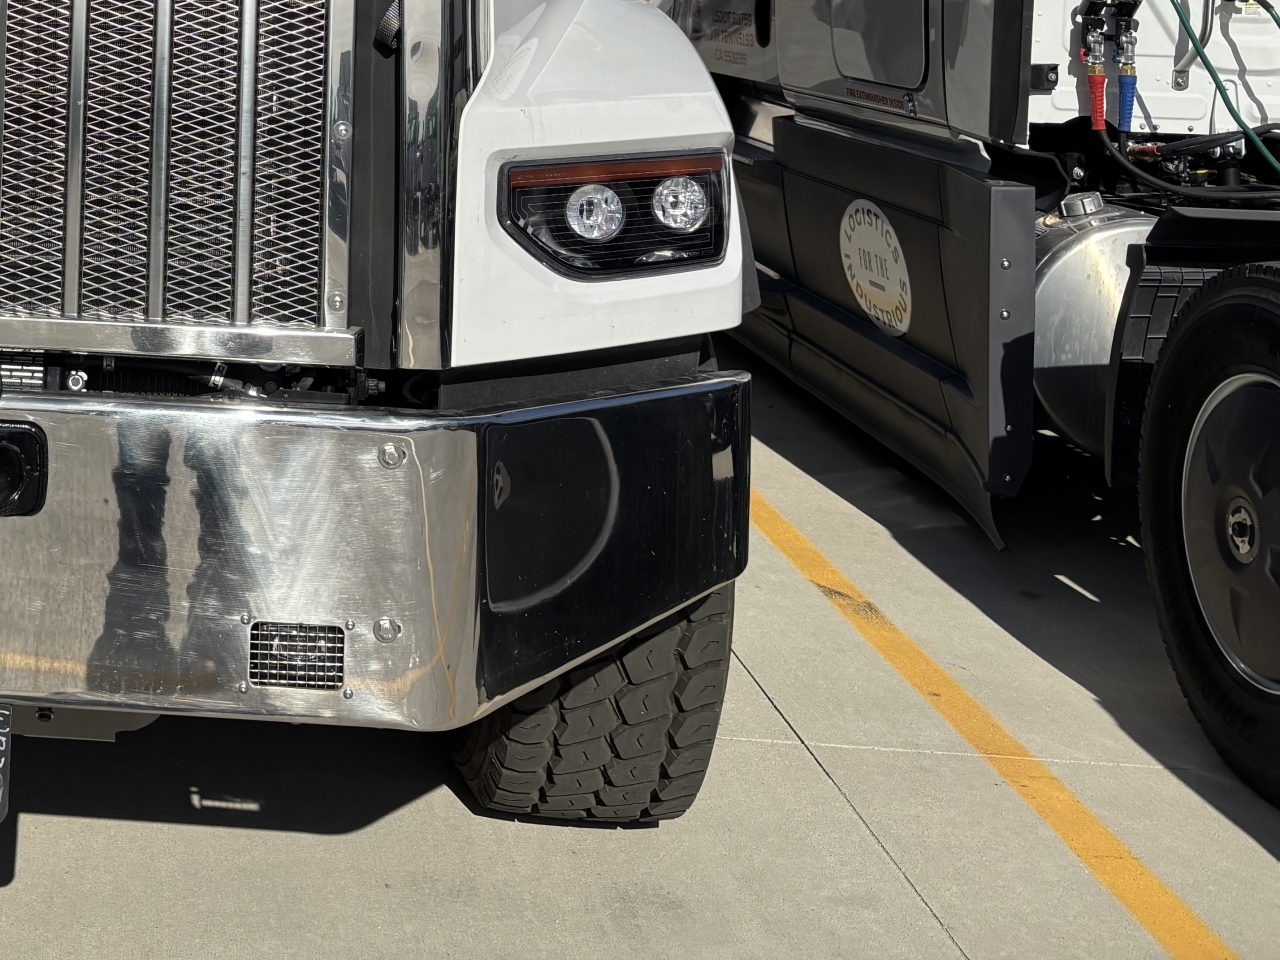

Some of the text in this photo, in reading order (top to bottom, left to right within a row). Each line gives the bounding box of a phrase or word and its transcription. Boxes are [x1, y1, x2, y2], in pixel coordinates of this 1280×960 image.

[844, 207, 900, 265] LOGISTICS
[858, 247, 890, 281] FOR THE
[844, 253, 908, 329] INDUSTRIOUS
